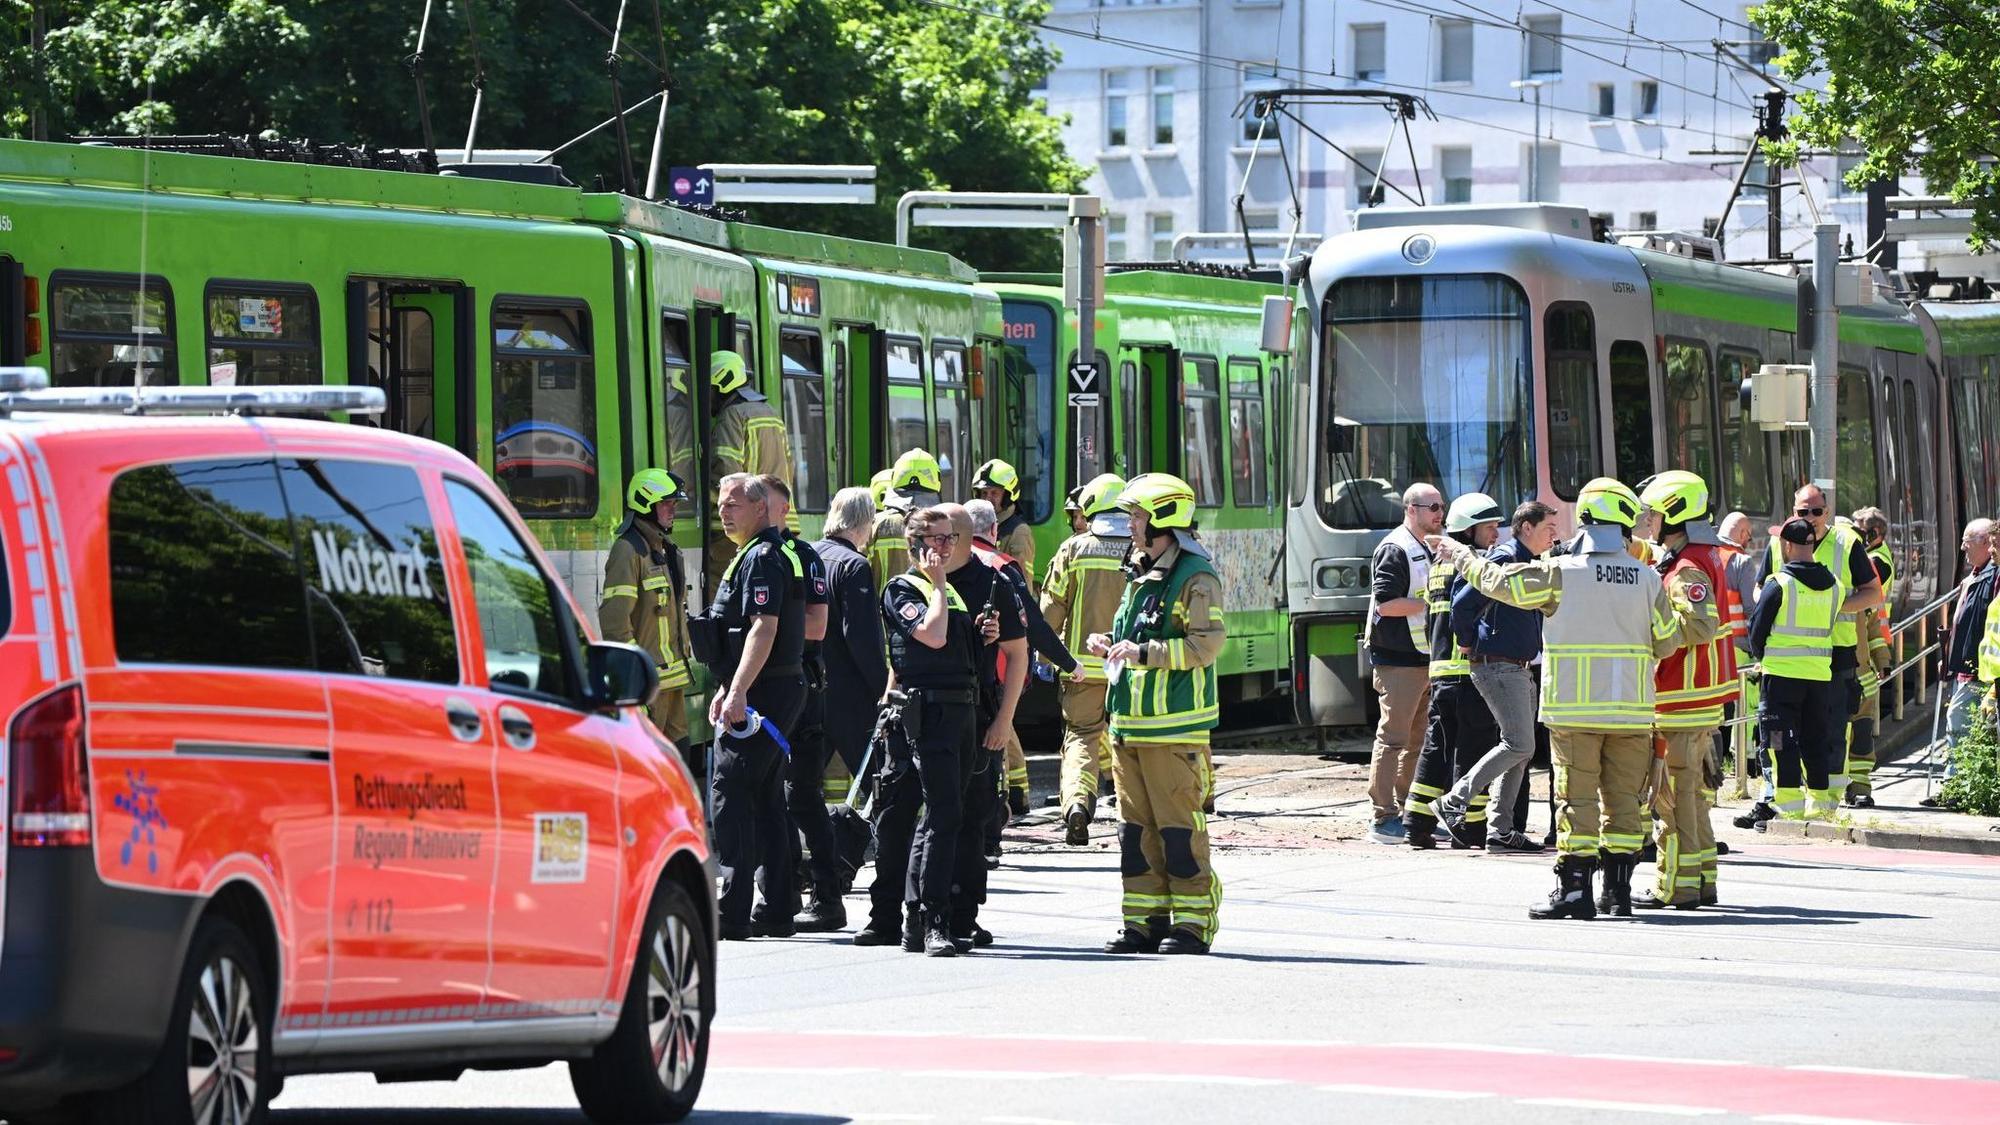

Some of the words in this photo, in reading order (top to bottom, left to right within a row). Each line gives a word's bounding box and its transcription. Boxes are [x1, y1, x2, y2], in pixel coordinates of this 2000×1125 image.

[311, 529, 434, 600] Notarzt
[1596, 564, 1640, 585] B-DIENST
[354, 772, 467, 821] Rettungsdienst
[353, 824, 408, 869] Region
[411, 826, 482, 860] Hannover
[366, 898, 394, 932] 112
